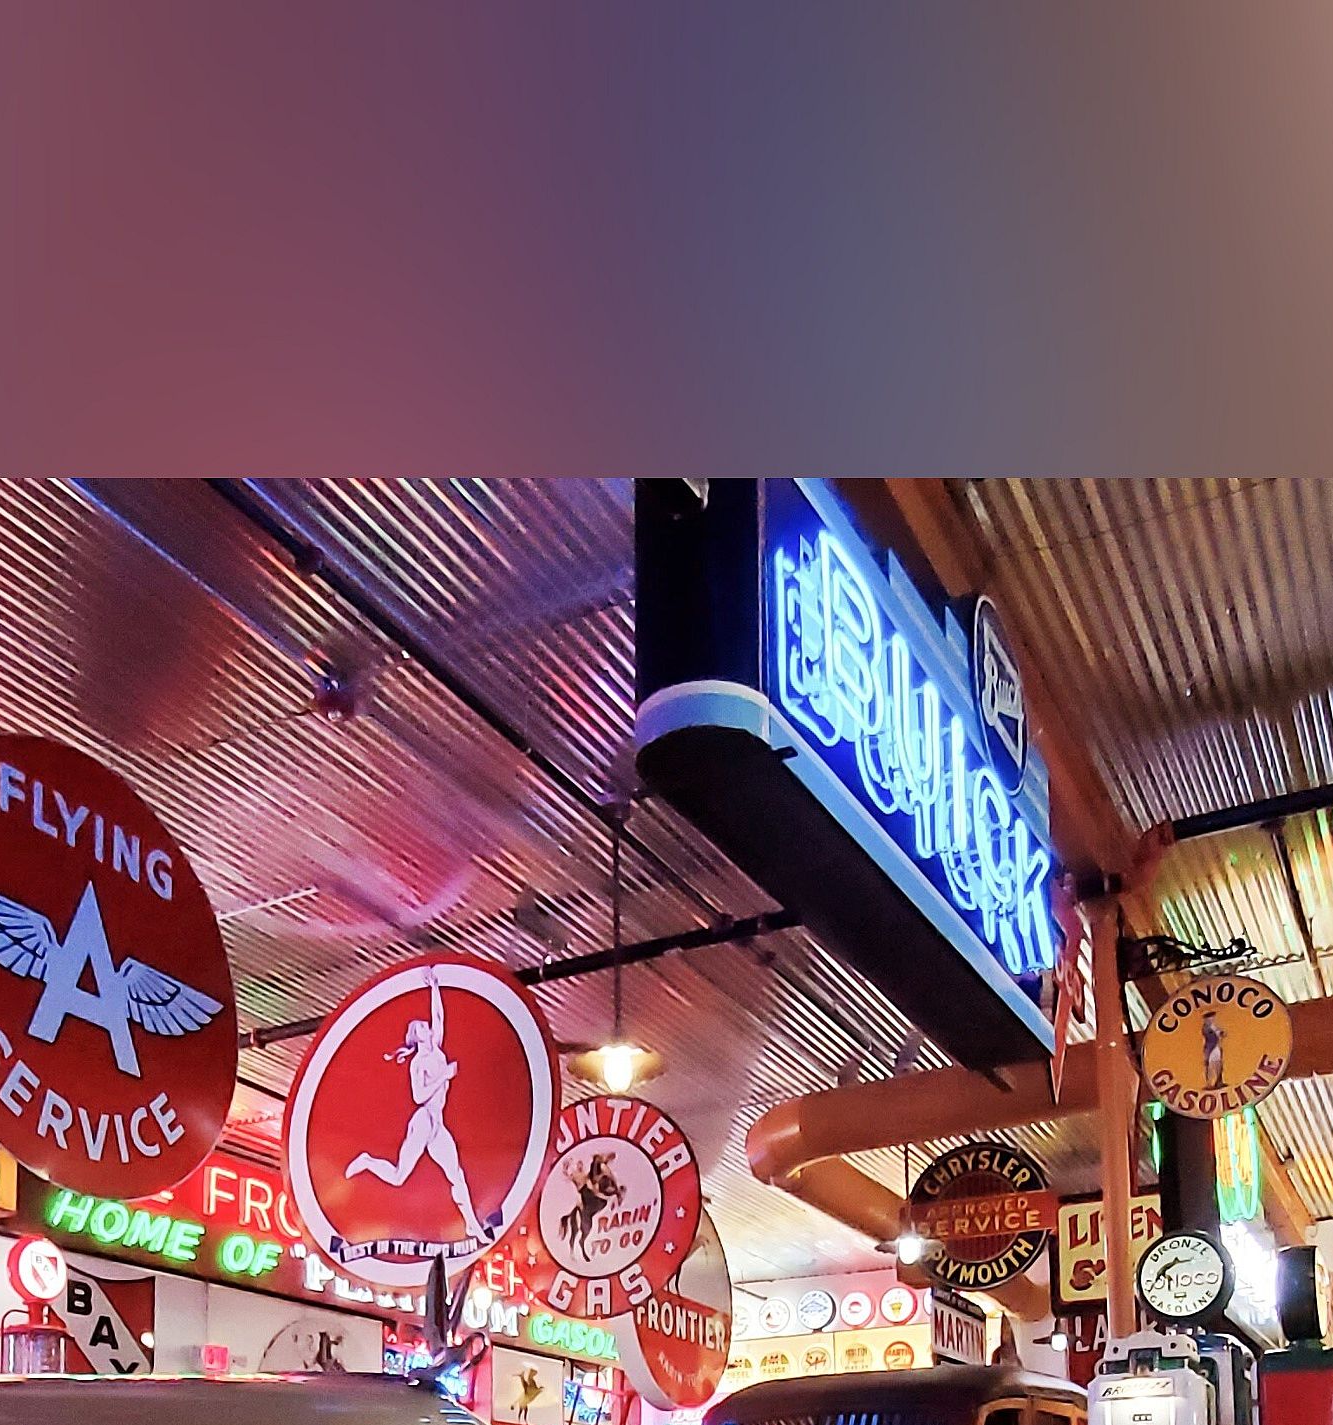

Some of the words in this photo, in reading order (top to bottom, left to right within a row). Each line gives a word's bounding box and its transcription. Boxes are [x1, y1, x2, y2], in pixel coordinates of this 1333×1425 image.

[1157, 982, 1274, 1034] CONOCO
[1151, 1054, 1284, 1114] GASOLINE
[923, 1151, 1031, 1195] CHRYSLER
[918, 1210, 1041, 1237] SERVICE
[377, 1240, 389, 1254] IN
[393, 1241, 416, 1256] THE
[925, 1238, 1034, 1285] PLYMOUTH
[1150, 1239, 1209, 1263] BRONZE
[50, 1189, 205, 1262] HOME
[221, 1233, 283, 1277] OF
[528, 1311, 621, 1360] GASOL
[548, 1264, 652, 1316] GAS
[1150, 1291, 1214, 1314] GASOLINE
